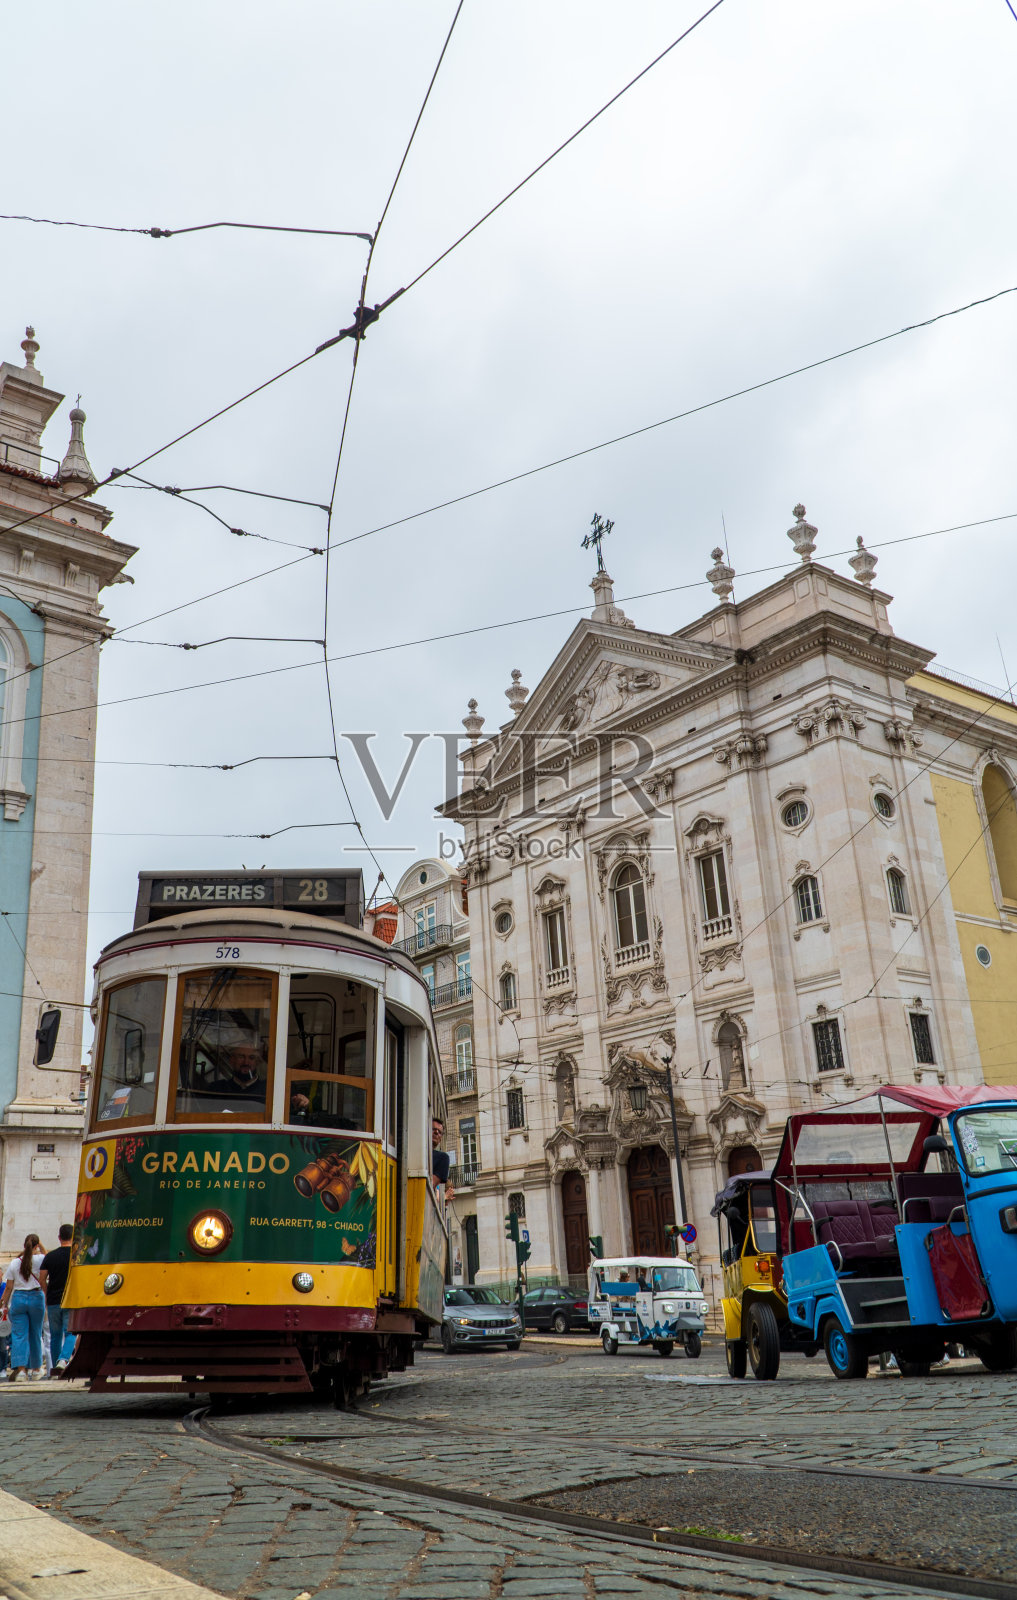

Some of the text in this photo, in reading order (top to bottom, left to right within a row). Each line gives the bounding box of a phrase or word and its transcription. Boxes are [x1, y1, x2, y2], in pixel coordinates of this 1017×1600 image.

[162, 884, 266, 901] PRAZERES
[298, 879, 329, 902] 28
[215, 947, 240, 959] 578
[142, 1151, 290, 1175] GRANADO
[159, 1180, 266, 1190] RIO DE JANEIRO
[95, 1216, 164, 1229] WWW.GRANADO.EU
[249, 1217, 270, 1226] RUA
[271, 1218, 315, 1230] GARRETT,
[316, 1220, 327, 1229] 98
[334, 1221, 364, 1232] CHIADO
